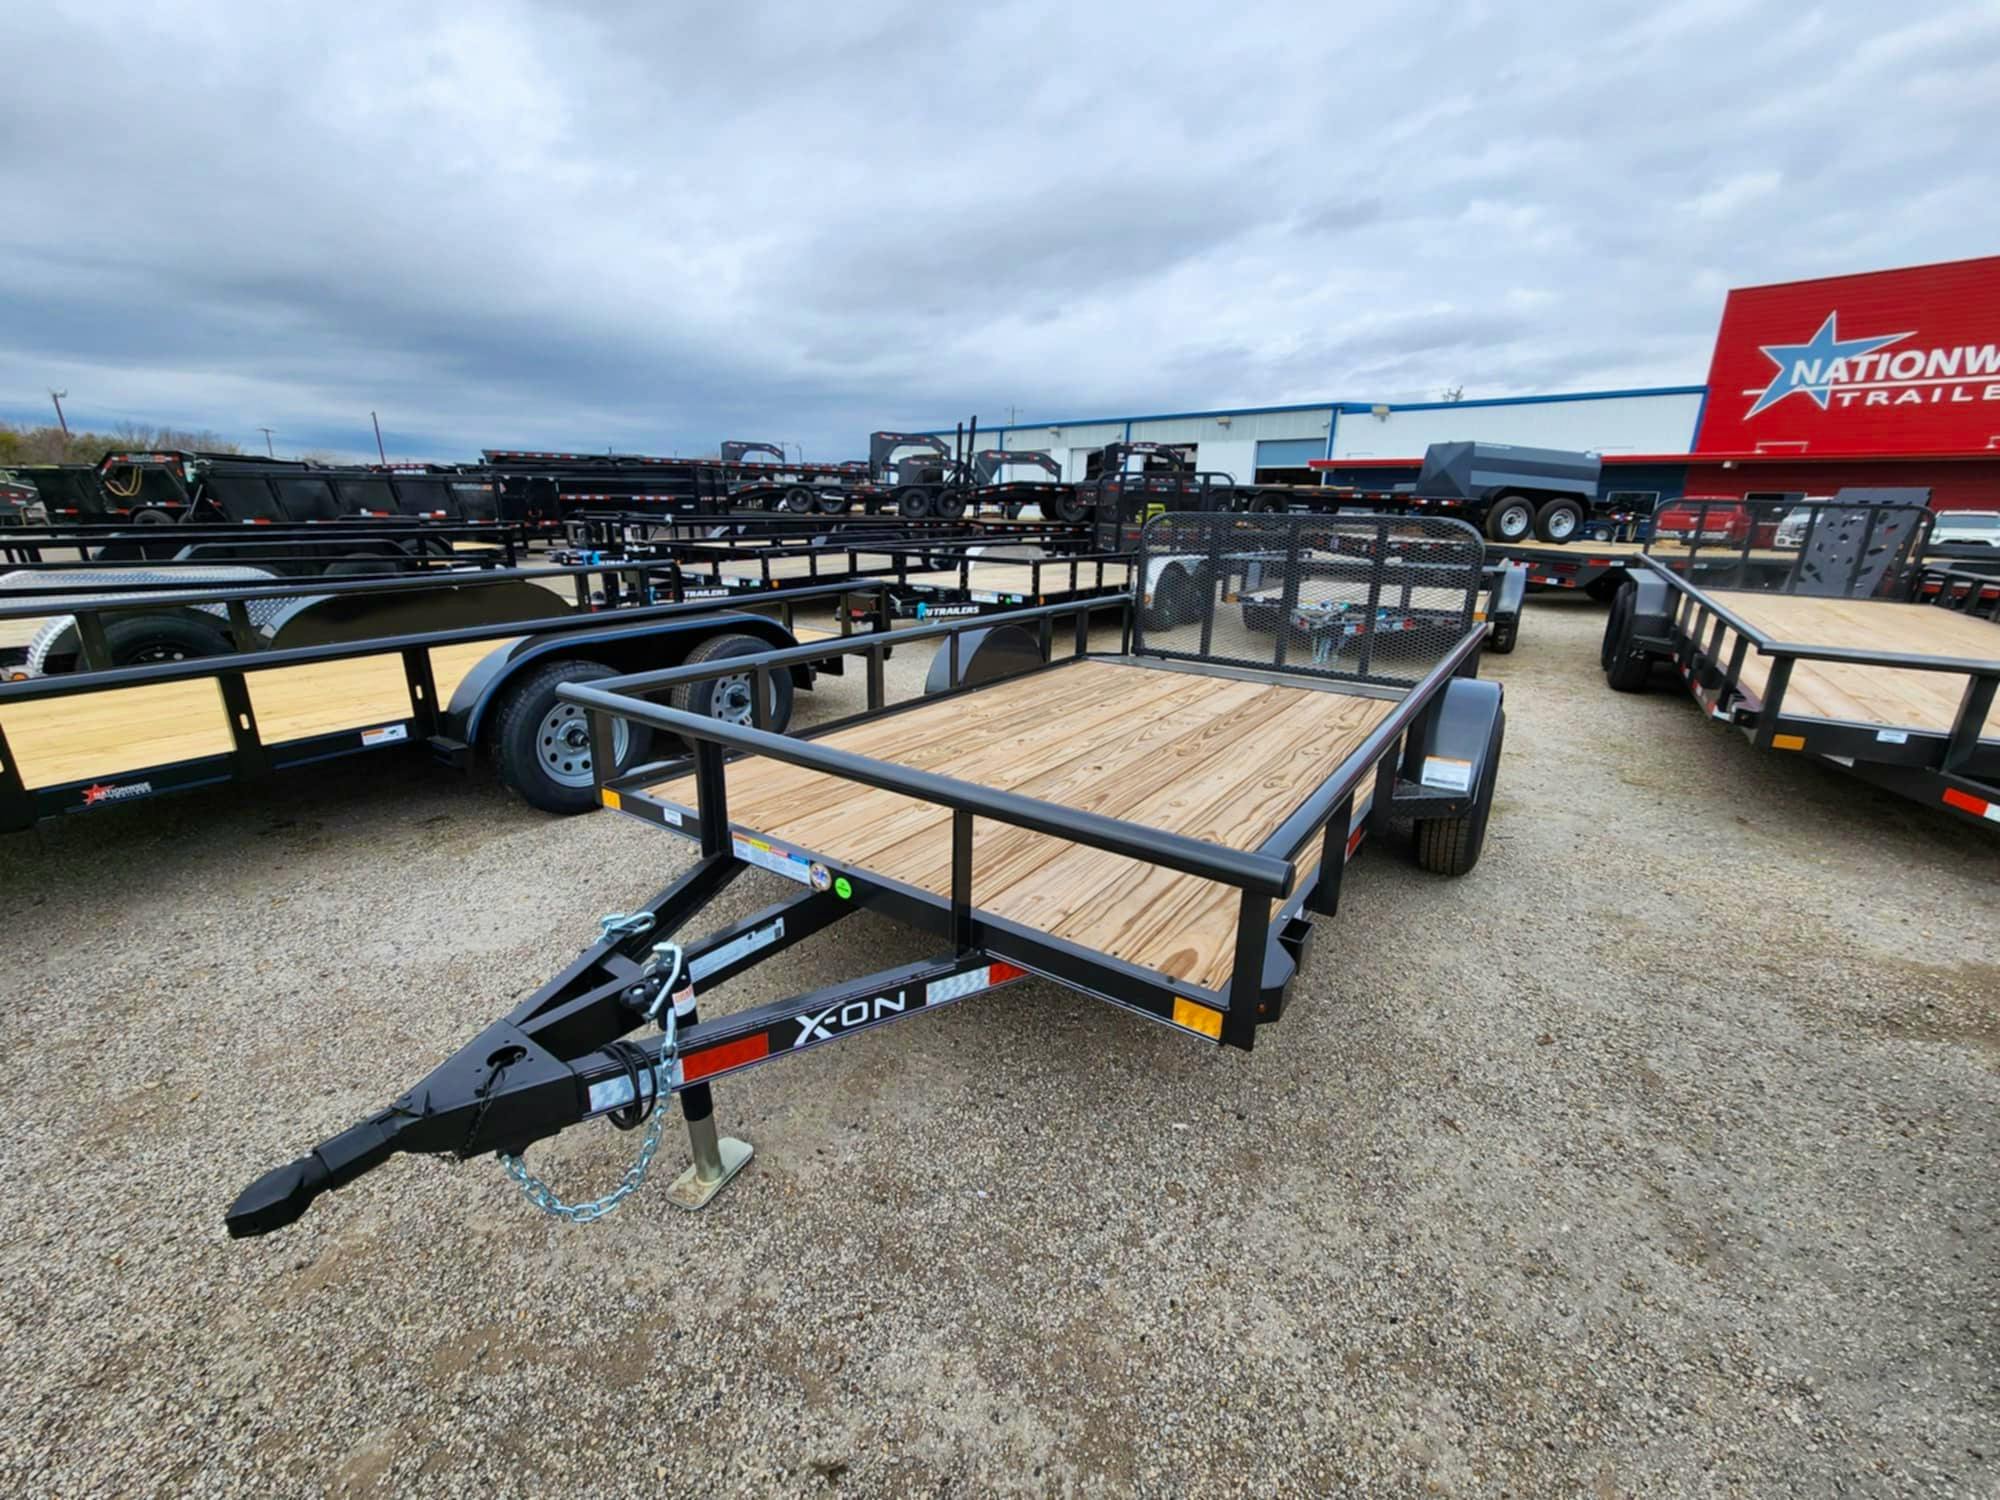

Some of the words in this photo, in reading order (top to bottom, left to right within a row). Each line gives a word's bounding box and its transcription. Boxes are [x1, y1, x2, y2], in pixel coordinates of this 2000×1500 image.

[1790, 344, 2000, 386] NATIONW
[1836, 385, 2000, 407] TRAILE
[683, 588, 729, 598] TRAILERS
[933, 605, 980, 616] TRAILERS
[794, 990, 906, 1047] X-ON
